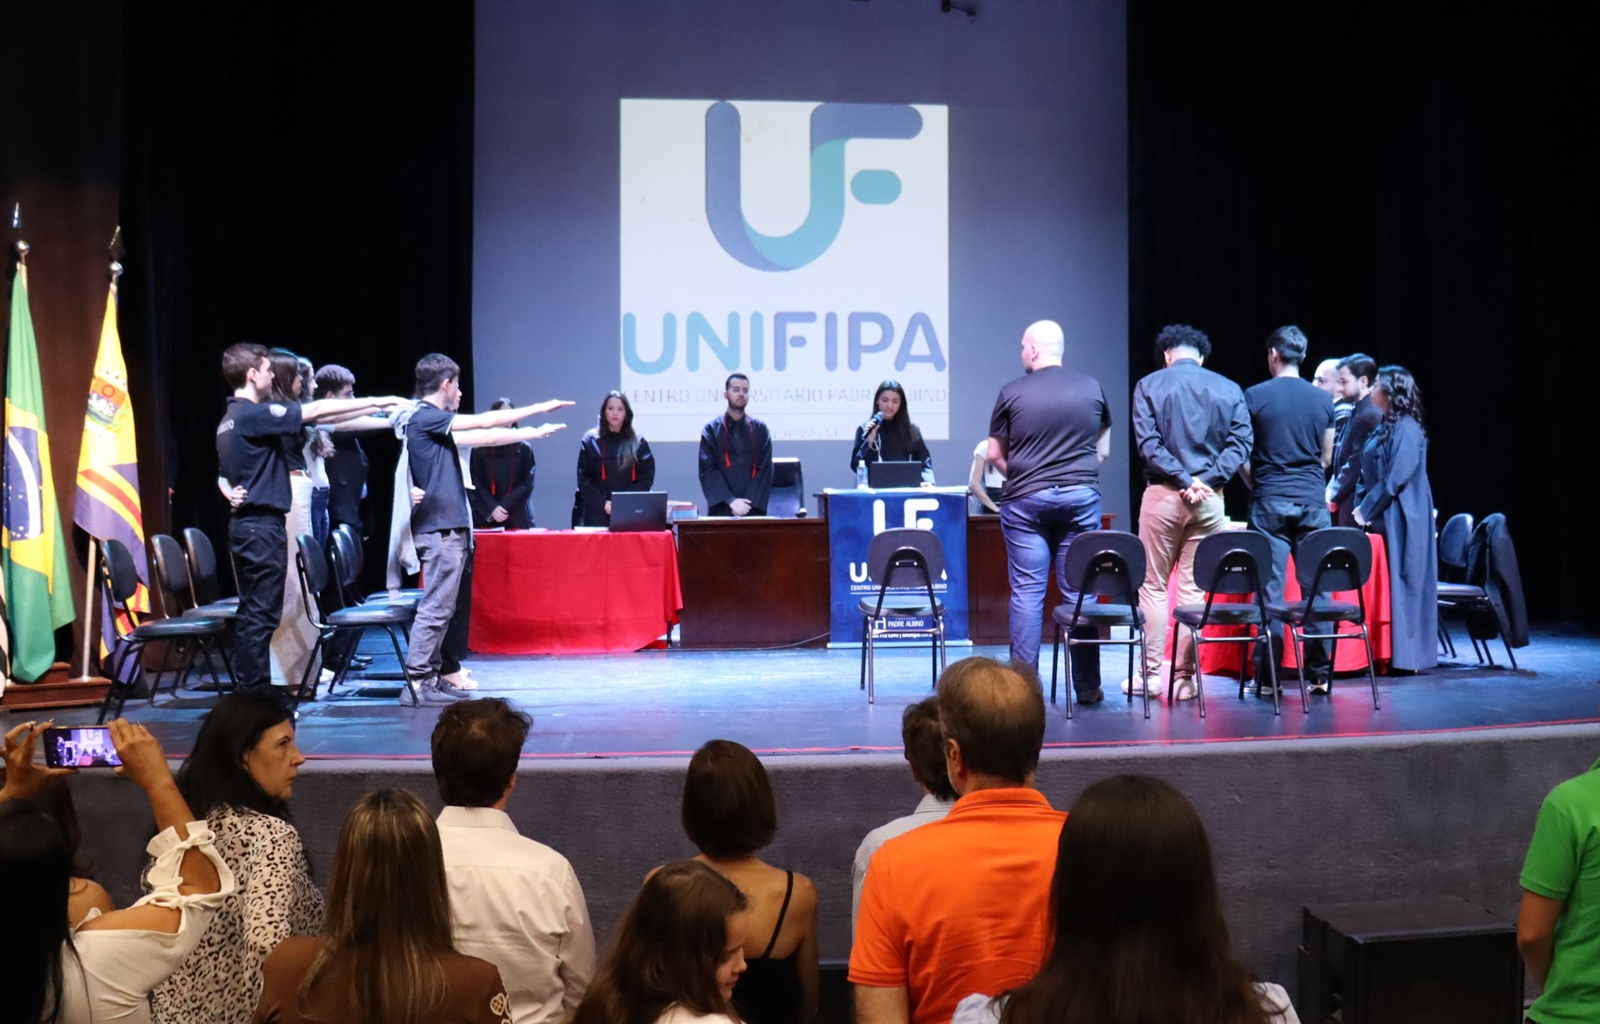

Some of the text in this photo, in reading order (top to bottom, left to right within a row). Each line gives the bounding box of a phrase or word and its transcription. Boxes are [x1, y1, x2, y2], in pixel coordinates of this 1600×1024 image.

[623, 311, 947, 375] UNIFIPA
[624, 388, 947, 403] ENTRO UNIRSITARIO PADR BINO
